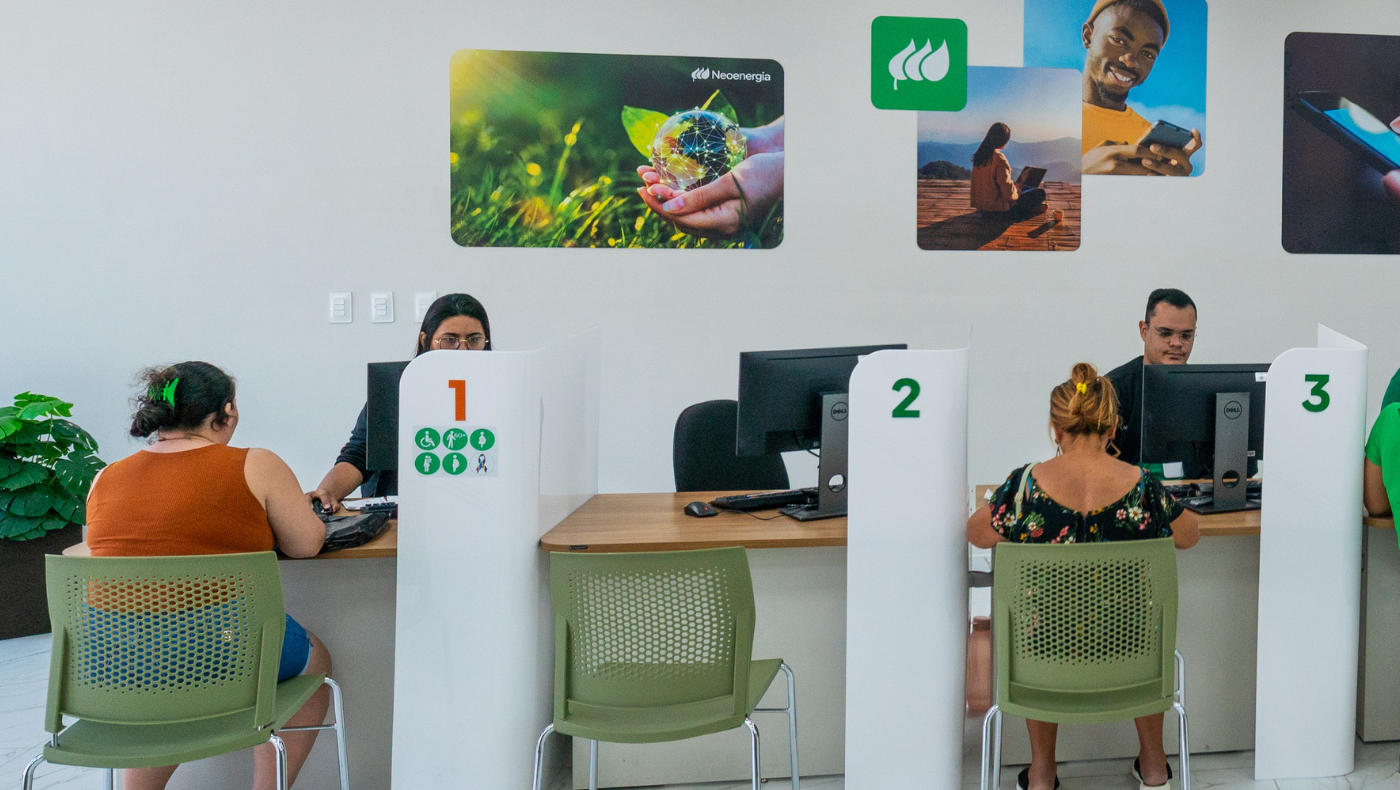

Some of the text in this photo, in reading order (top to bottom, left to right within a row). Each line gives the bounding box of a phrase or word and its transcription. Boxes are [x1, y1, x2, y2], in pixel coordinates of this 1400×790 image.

[711, 69, 772, 83] Neoenergia
[448, 379, 466, 422] 1
[891, 377, 921, 418] 2
[1301, 374, 1331, 413] 3
